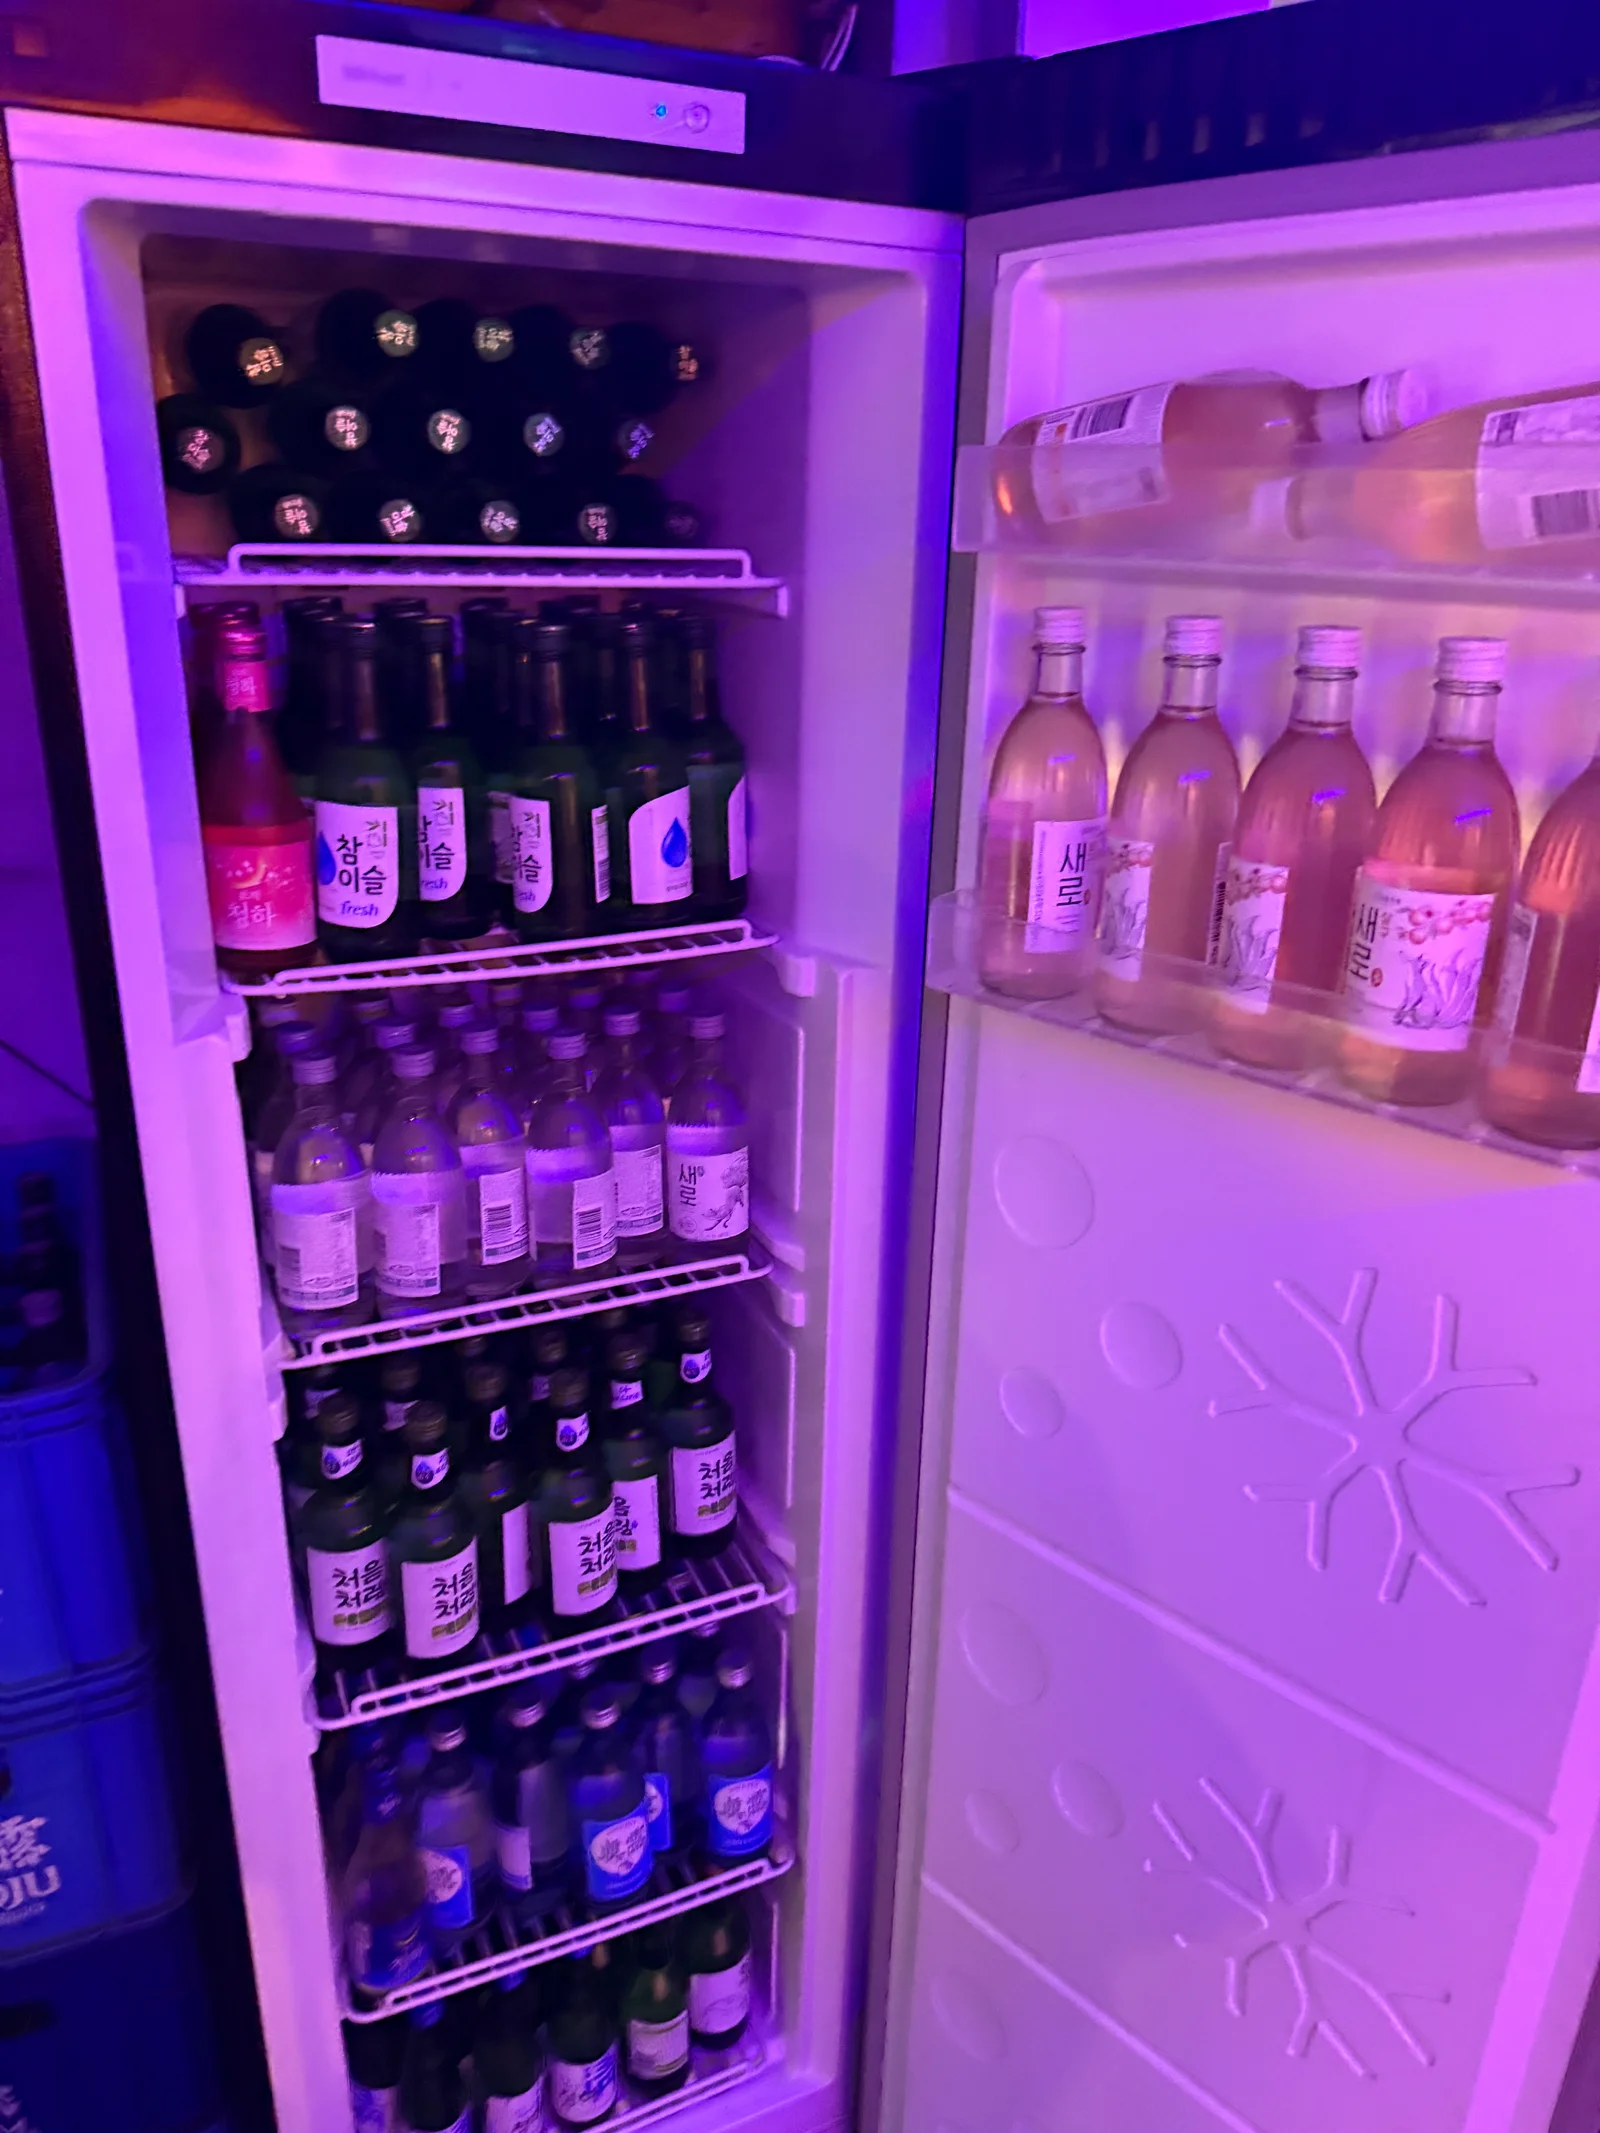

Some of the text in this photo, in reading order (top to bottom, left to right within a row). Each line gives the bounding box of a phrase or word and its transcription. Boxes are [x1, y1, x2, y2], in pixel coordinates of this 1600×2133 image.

[336, 834, 363, 865] 참
[339, 864, 386, 895] 이슬
[420, 878, 448, 890] resh
[1055, 842, 1088, 907] 새로
[340, 901, 379, 916] fresh
[1350, 904, 1379, 980] 새로
[679, 1163, 697, 1207] 새로
[698, 1450, 733, 1481] 처음
[332, 1559, 384, 1589] 처음
[432, 1561, 474, 1598] 처음
